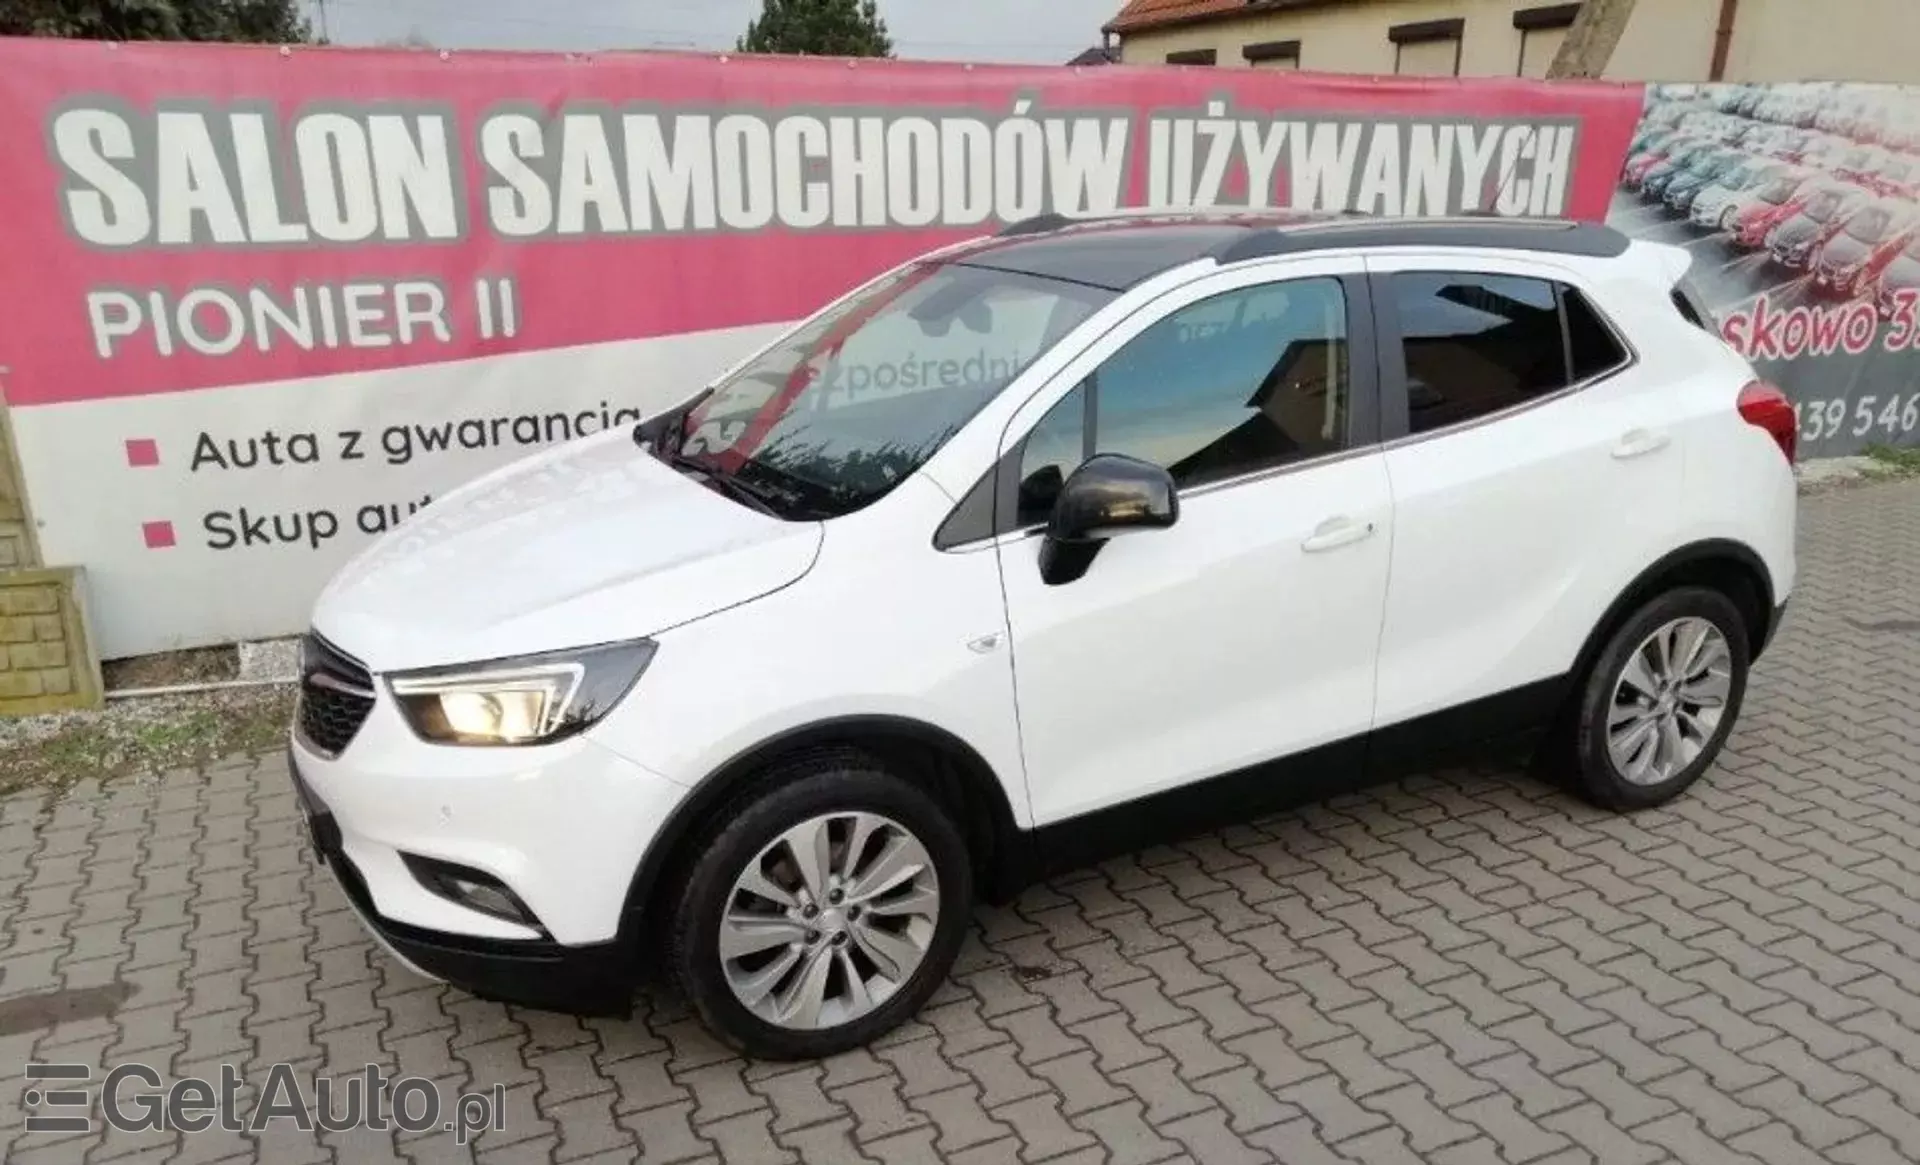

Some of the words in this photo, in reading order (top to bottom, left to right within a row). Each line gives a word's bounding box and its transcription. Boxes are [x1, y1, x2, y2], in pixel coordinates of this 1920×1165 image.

[53, 108, 458, 245] SALON
[481, 100, 1129, 237] SAMOCHODÓW
[1149, 100, 1576, 217] UŻYWANYCH
[87, 281, 450, 358] PIONIER
[476, 278, 515, 339] II
[1884, 288, 1920, 352] 3
[1852, 393, 1920, 438] 546
[190, 430, 320, 472] Auta
[337, 430, 365, 460] z
[202, 507, 339, 549] Skup
